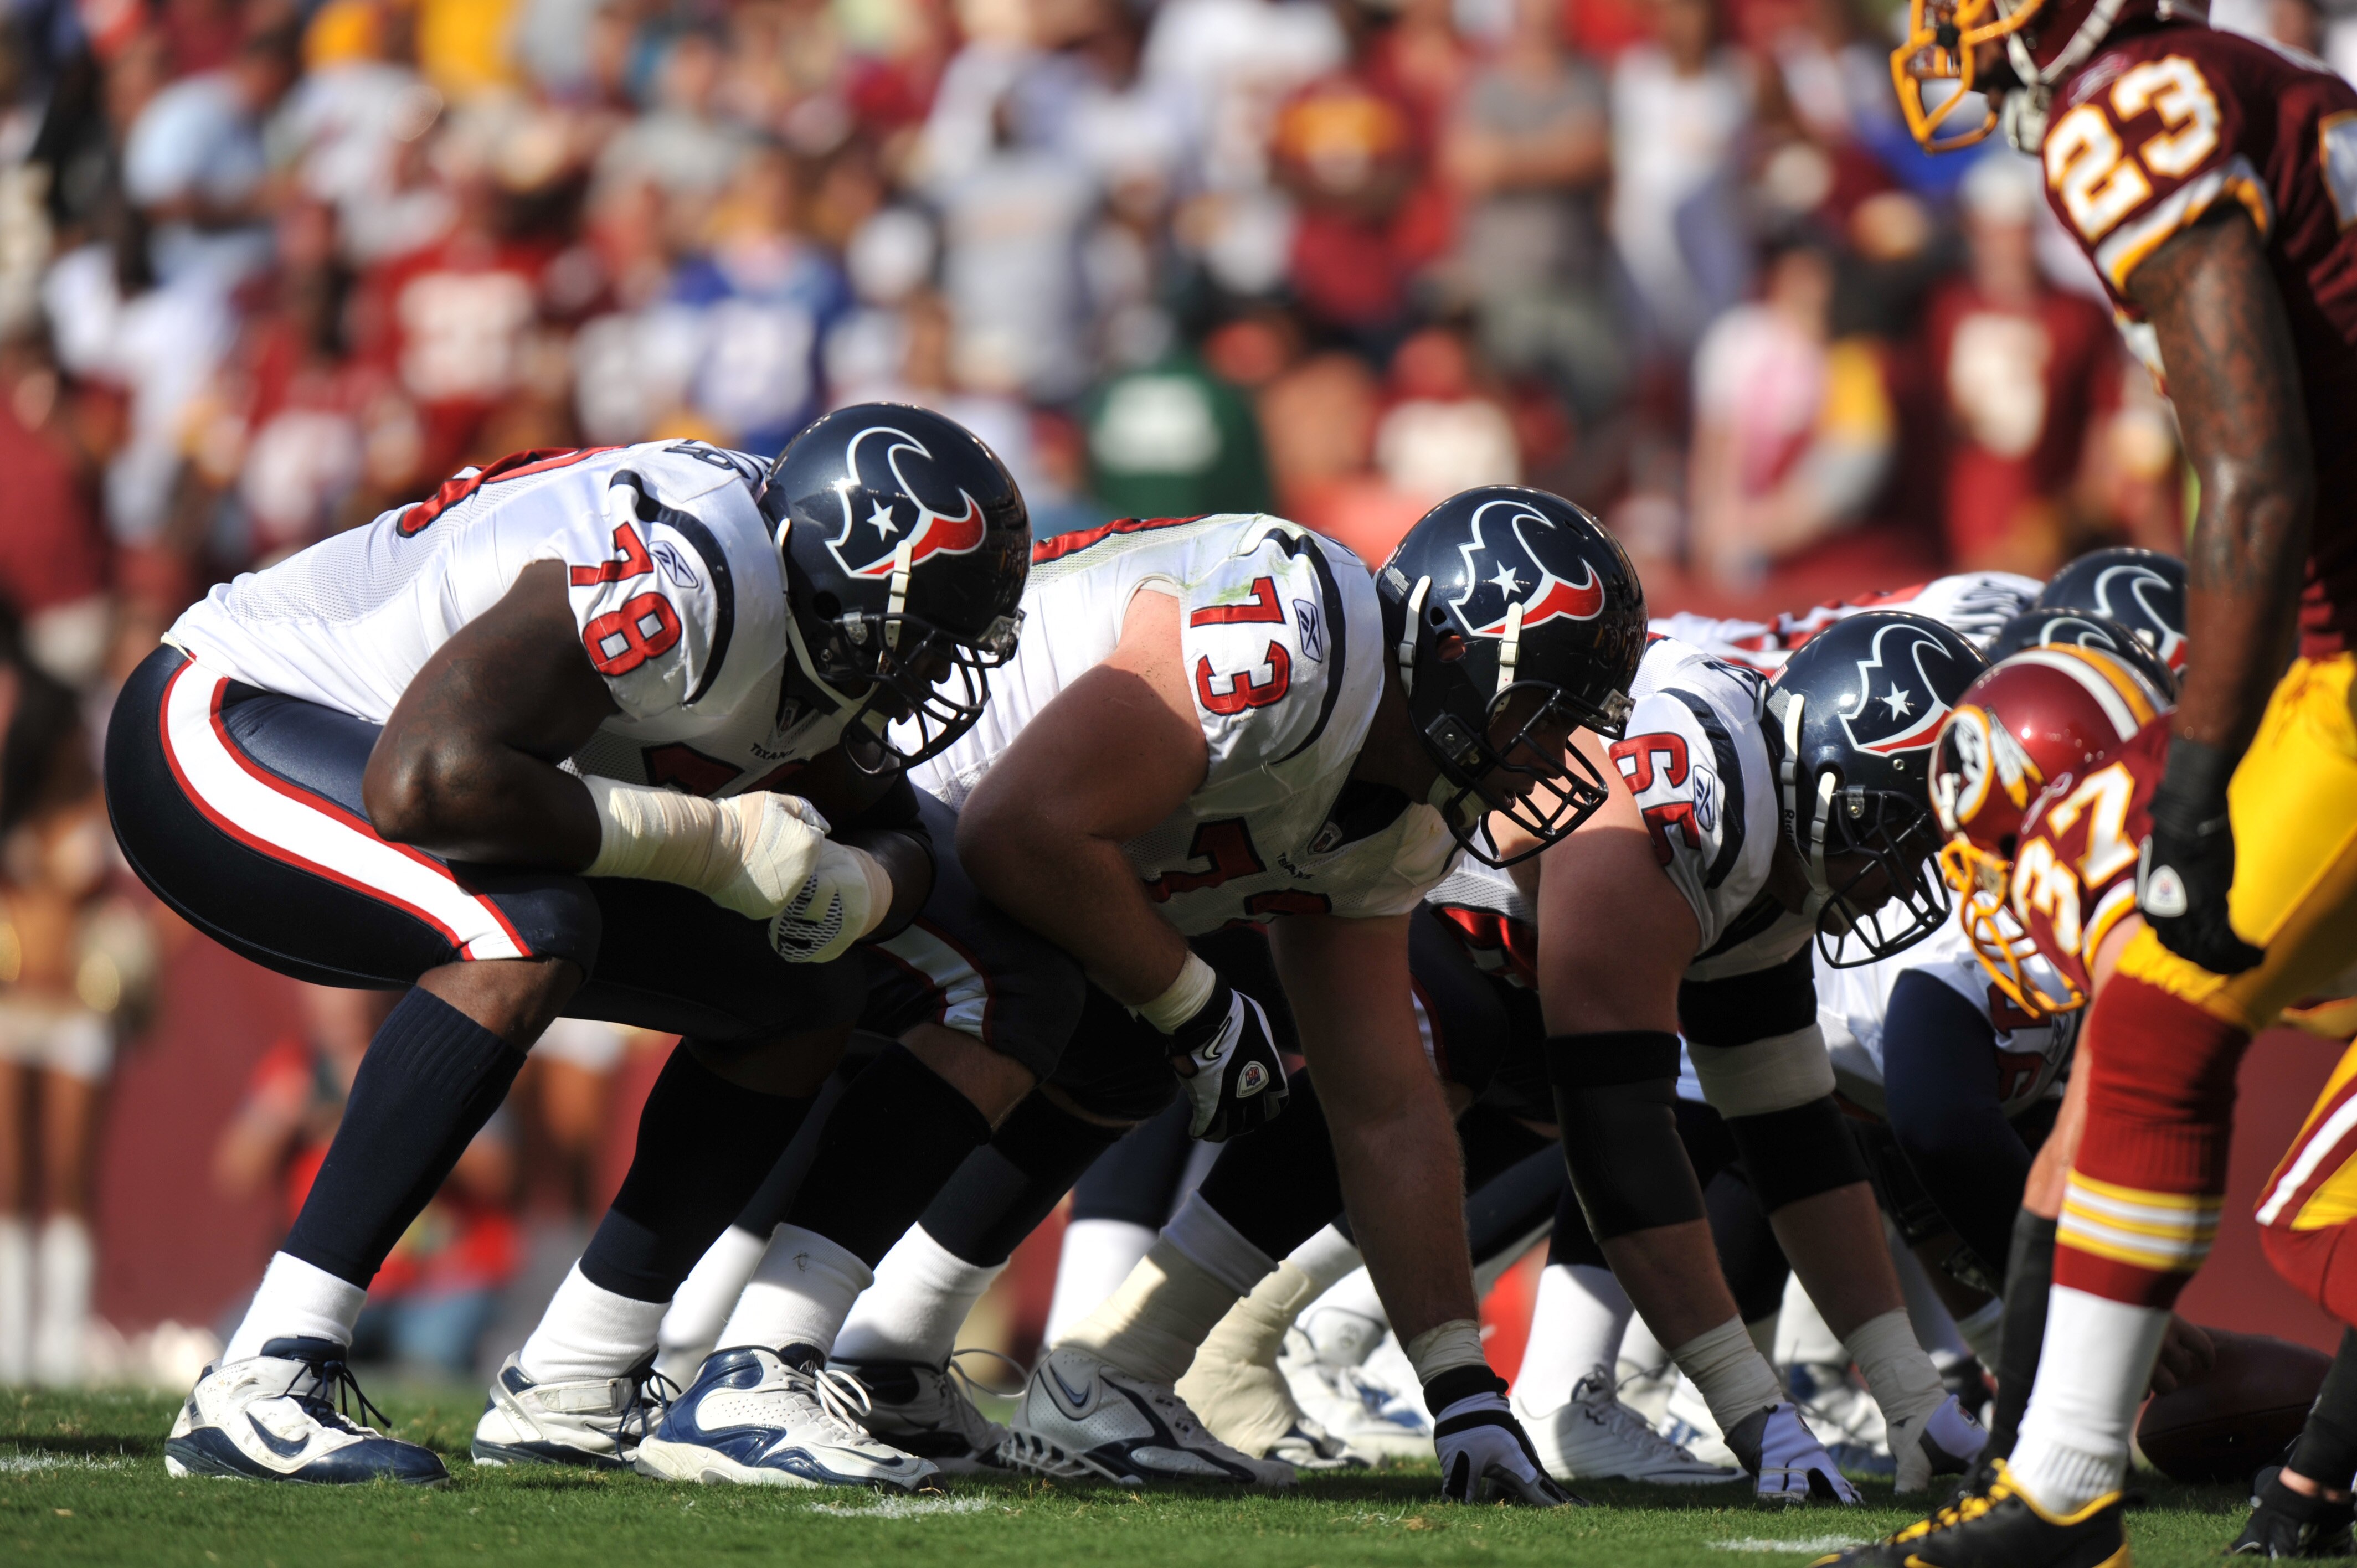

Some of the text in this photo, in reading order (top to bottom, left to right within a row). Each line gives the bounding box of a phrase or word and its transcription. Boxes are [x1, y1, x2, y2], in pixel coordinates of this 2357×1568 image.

[2043, 53, 2221, 245] 23
[569, 520, 682, 677] 78
[1190, 575, 1292, 716] 73
[1608, 731, 1702, 866] 65
[2010, 760, 2139, 958] 37
